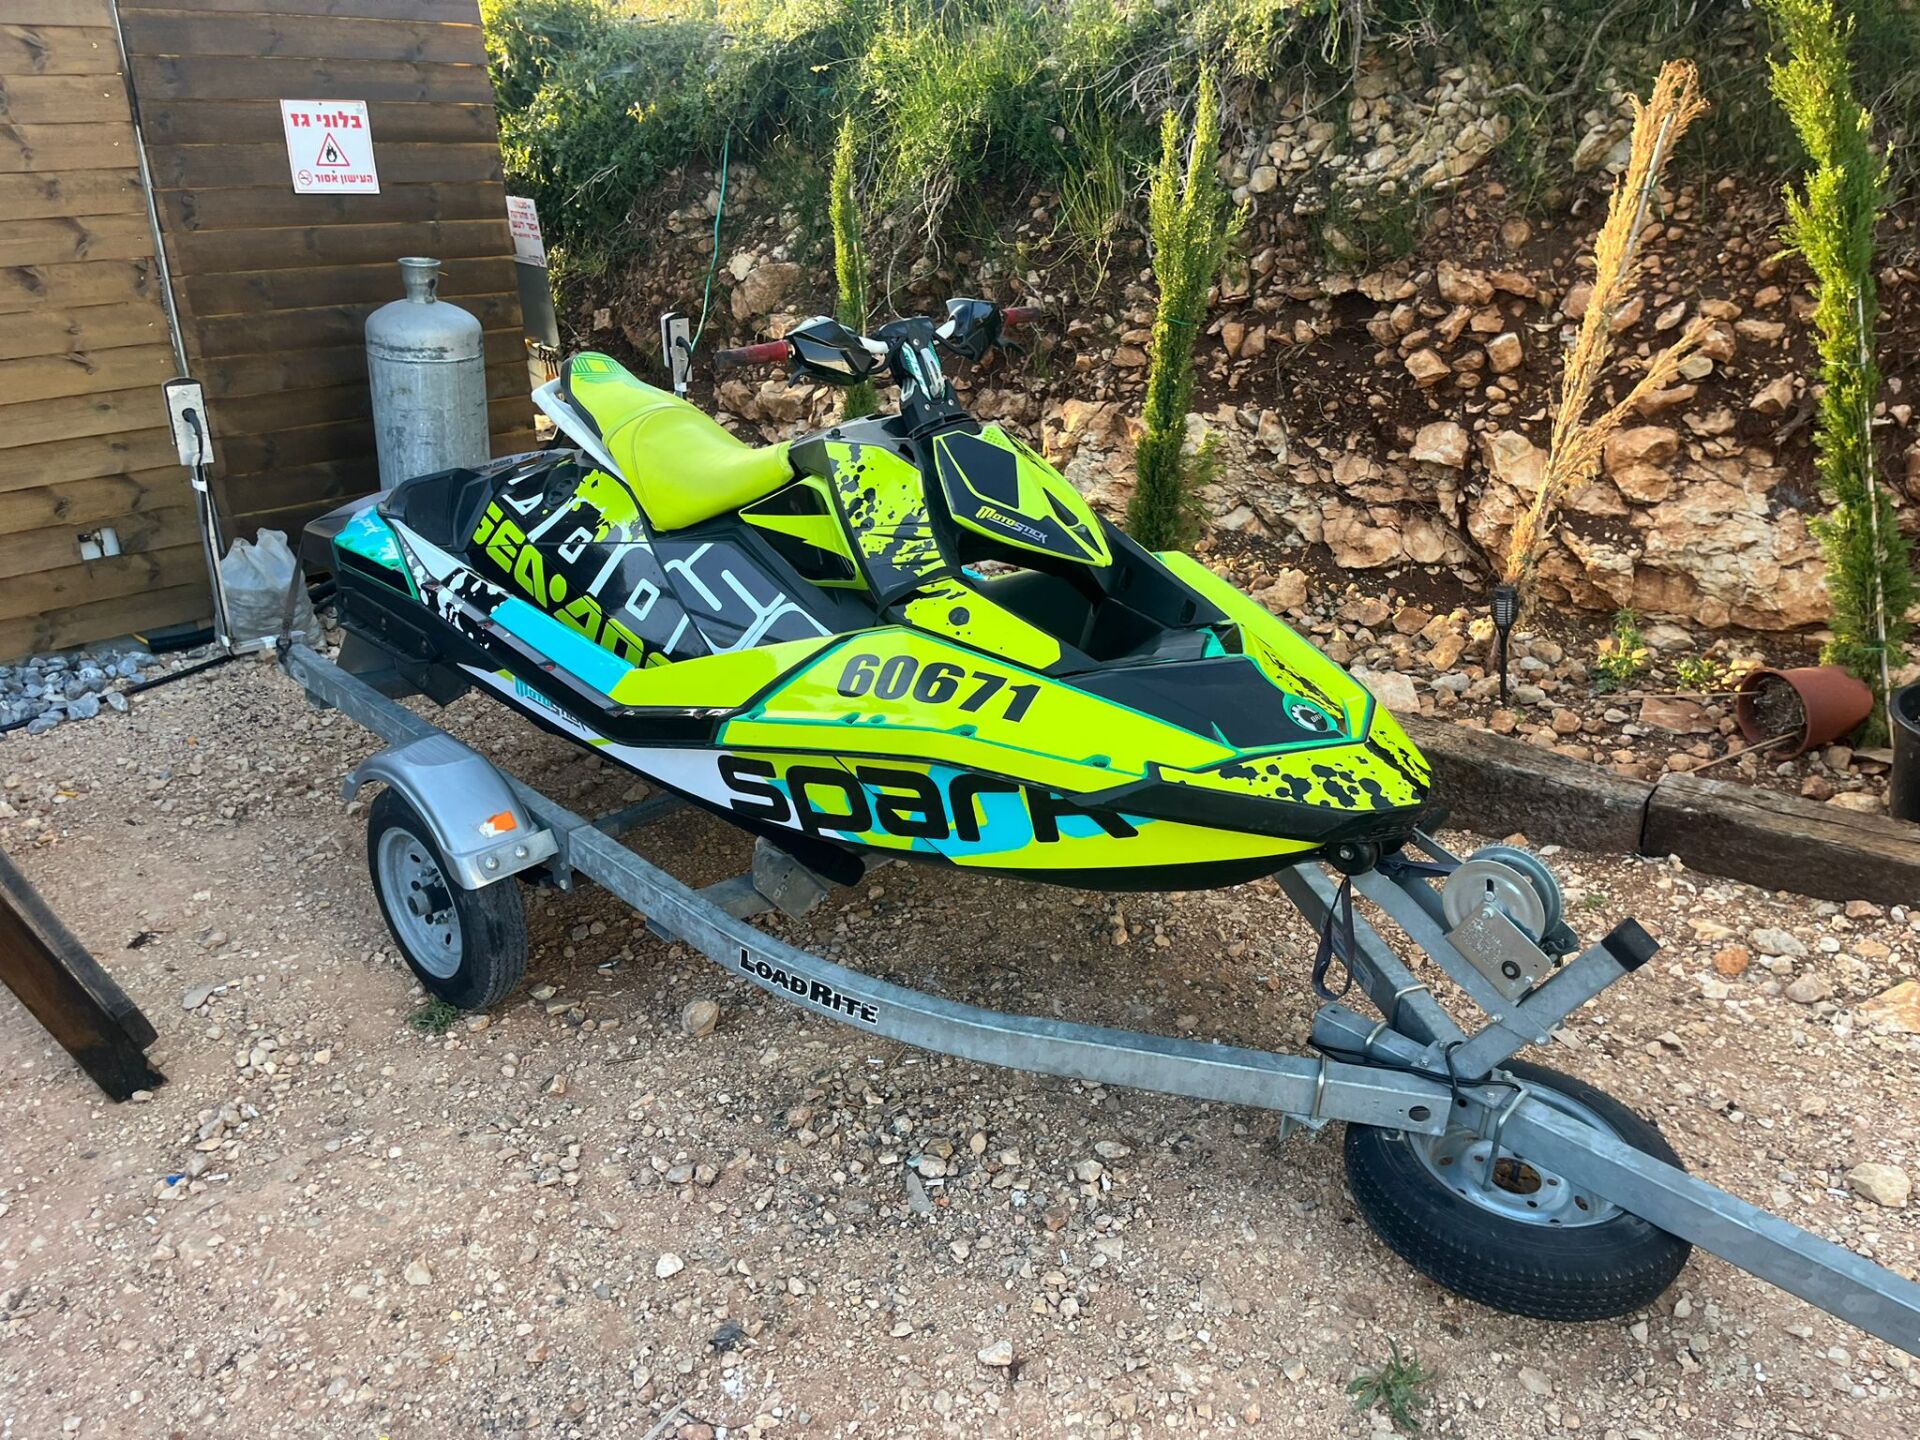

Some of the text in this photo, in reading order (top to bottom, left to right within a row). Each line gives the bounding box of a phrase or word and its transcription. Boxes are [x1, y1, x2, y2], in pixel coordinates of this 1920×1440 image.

[291, 111, 362, 129] בלוני גז
[315, 174, 374, 185] העישון אסור
[836, 653, 1041, 723] 60671
